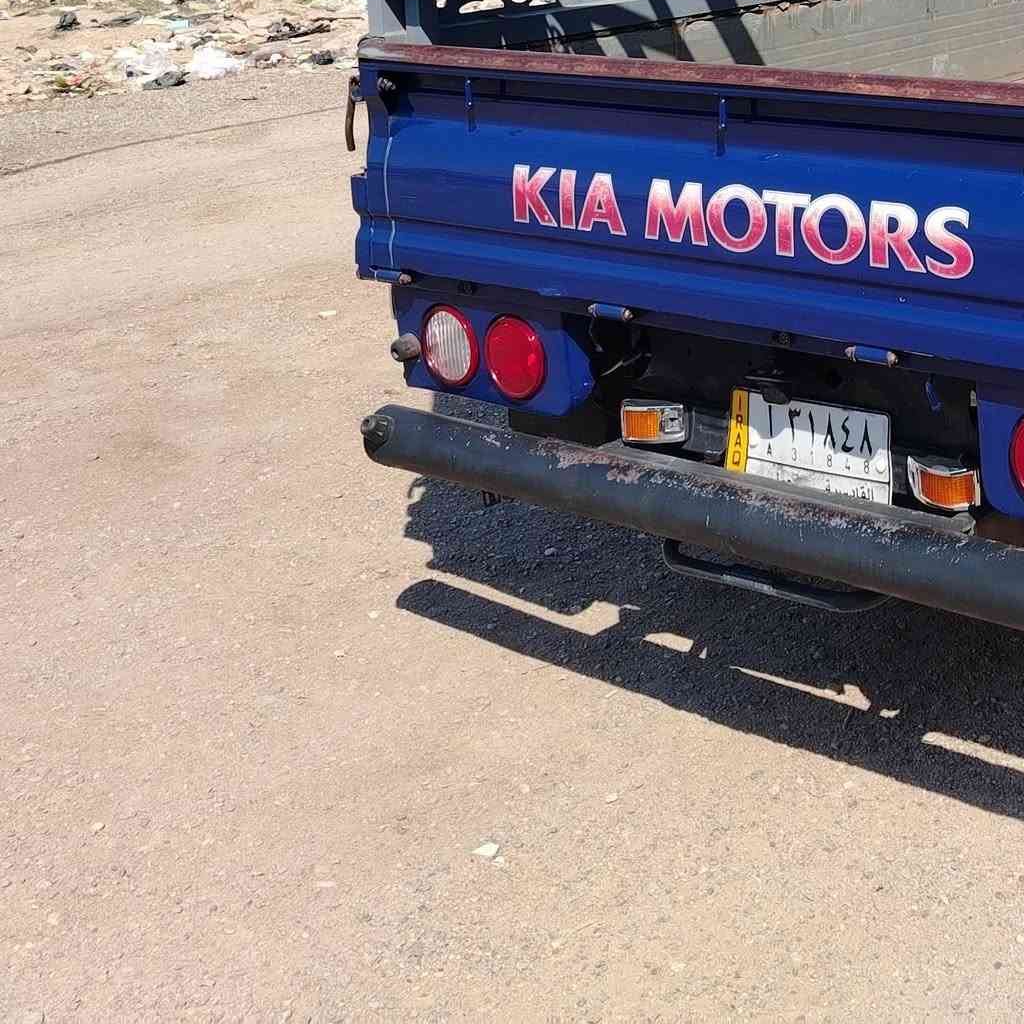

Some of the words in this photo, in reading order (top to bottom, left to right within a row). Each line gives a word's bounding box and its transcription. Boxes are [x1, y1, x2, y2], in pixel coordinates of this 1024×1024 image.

[512, 164, 627, 236] KIA
[644, 177, 975, 280] MOTORS
[732, 395, 745, 467] IRAQ
